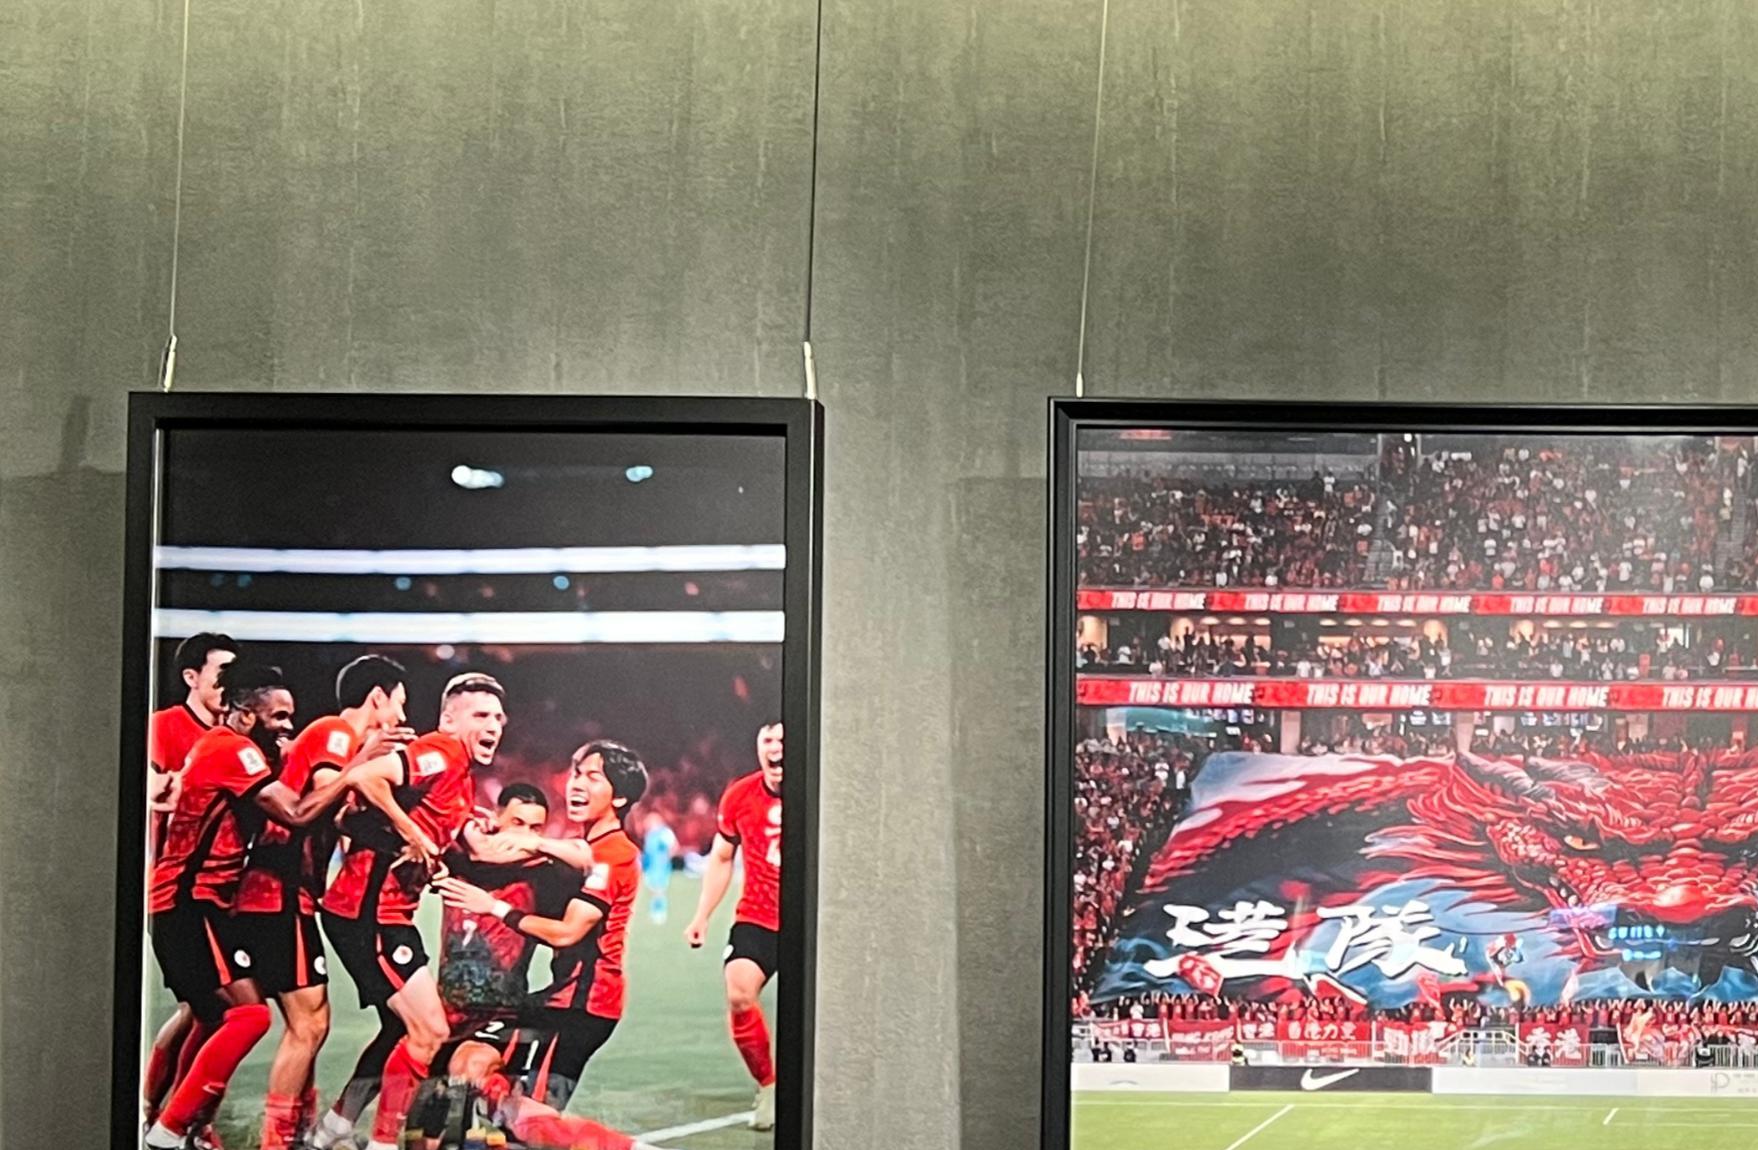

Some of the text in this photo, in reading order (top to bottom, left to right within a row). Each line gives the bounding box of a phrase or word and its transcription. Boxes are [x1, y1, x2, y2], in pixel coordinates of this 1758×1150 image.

[1128, 682, 1255, 704] THIS IS OUR HOME
[1306, 684, 1432, 706] THIS IS OUR HOME
[1484, 686, 1610, 707] THIS IS OUR HOME
[1663, 686, 1694, 708] THIS
[1696, 686, 1713, 708] IS
[1714, 686, 1744, 708] OUR
